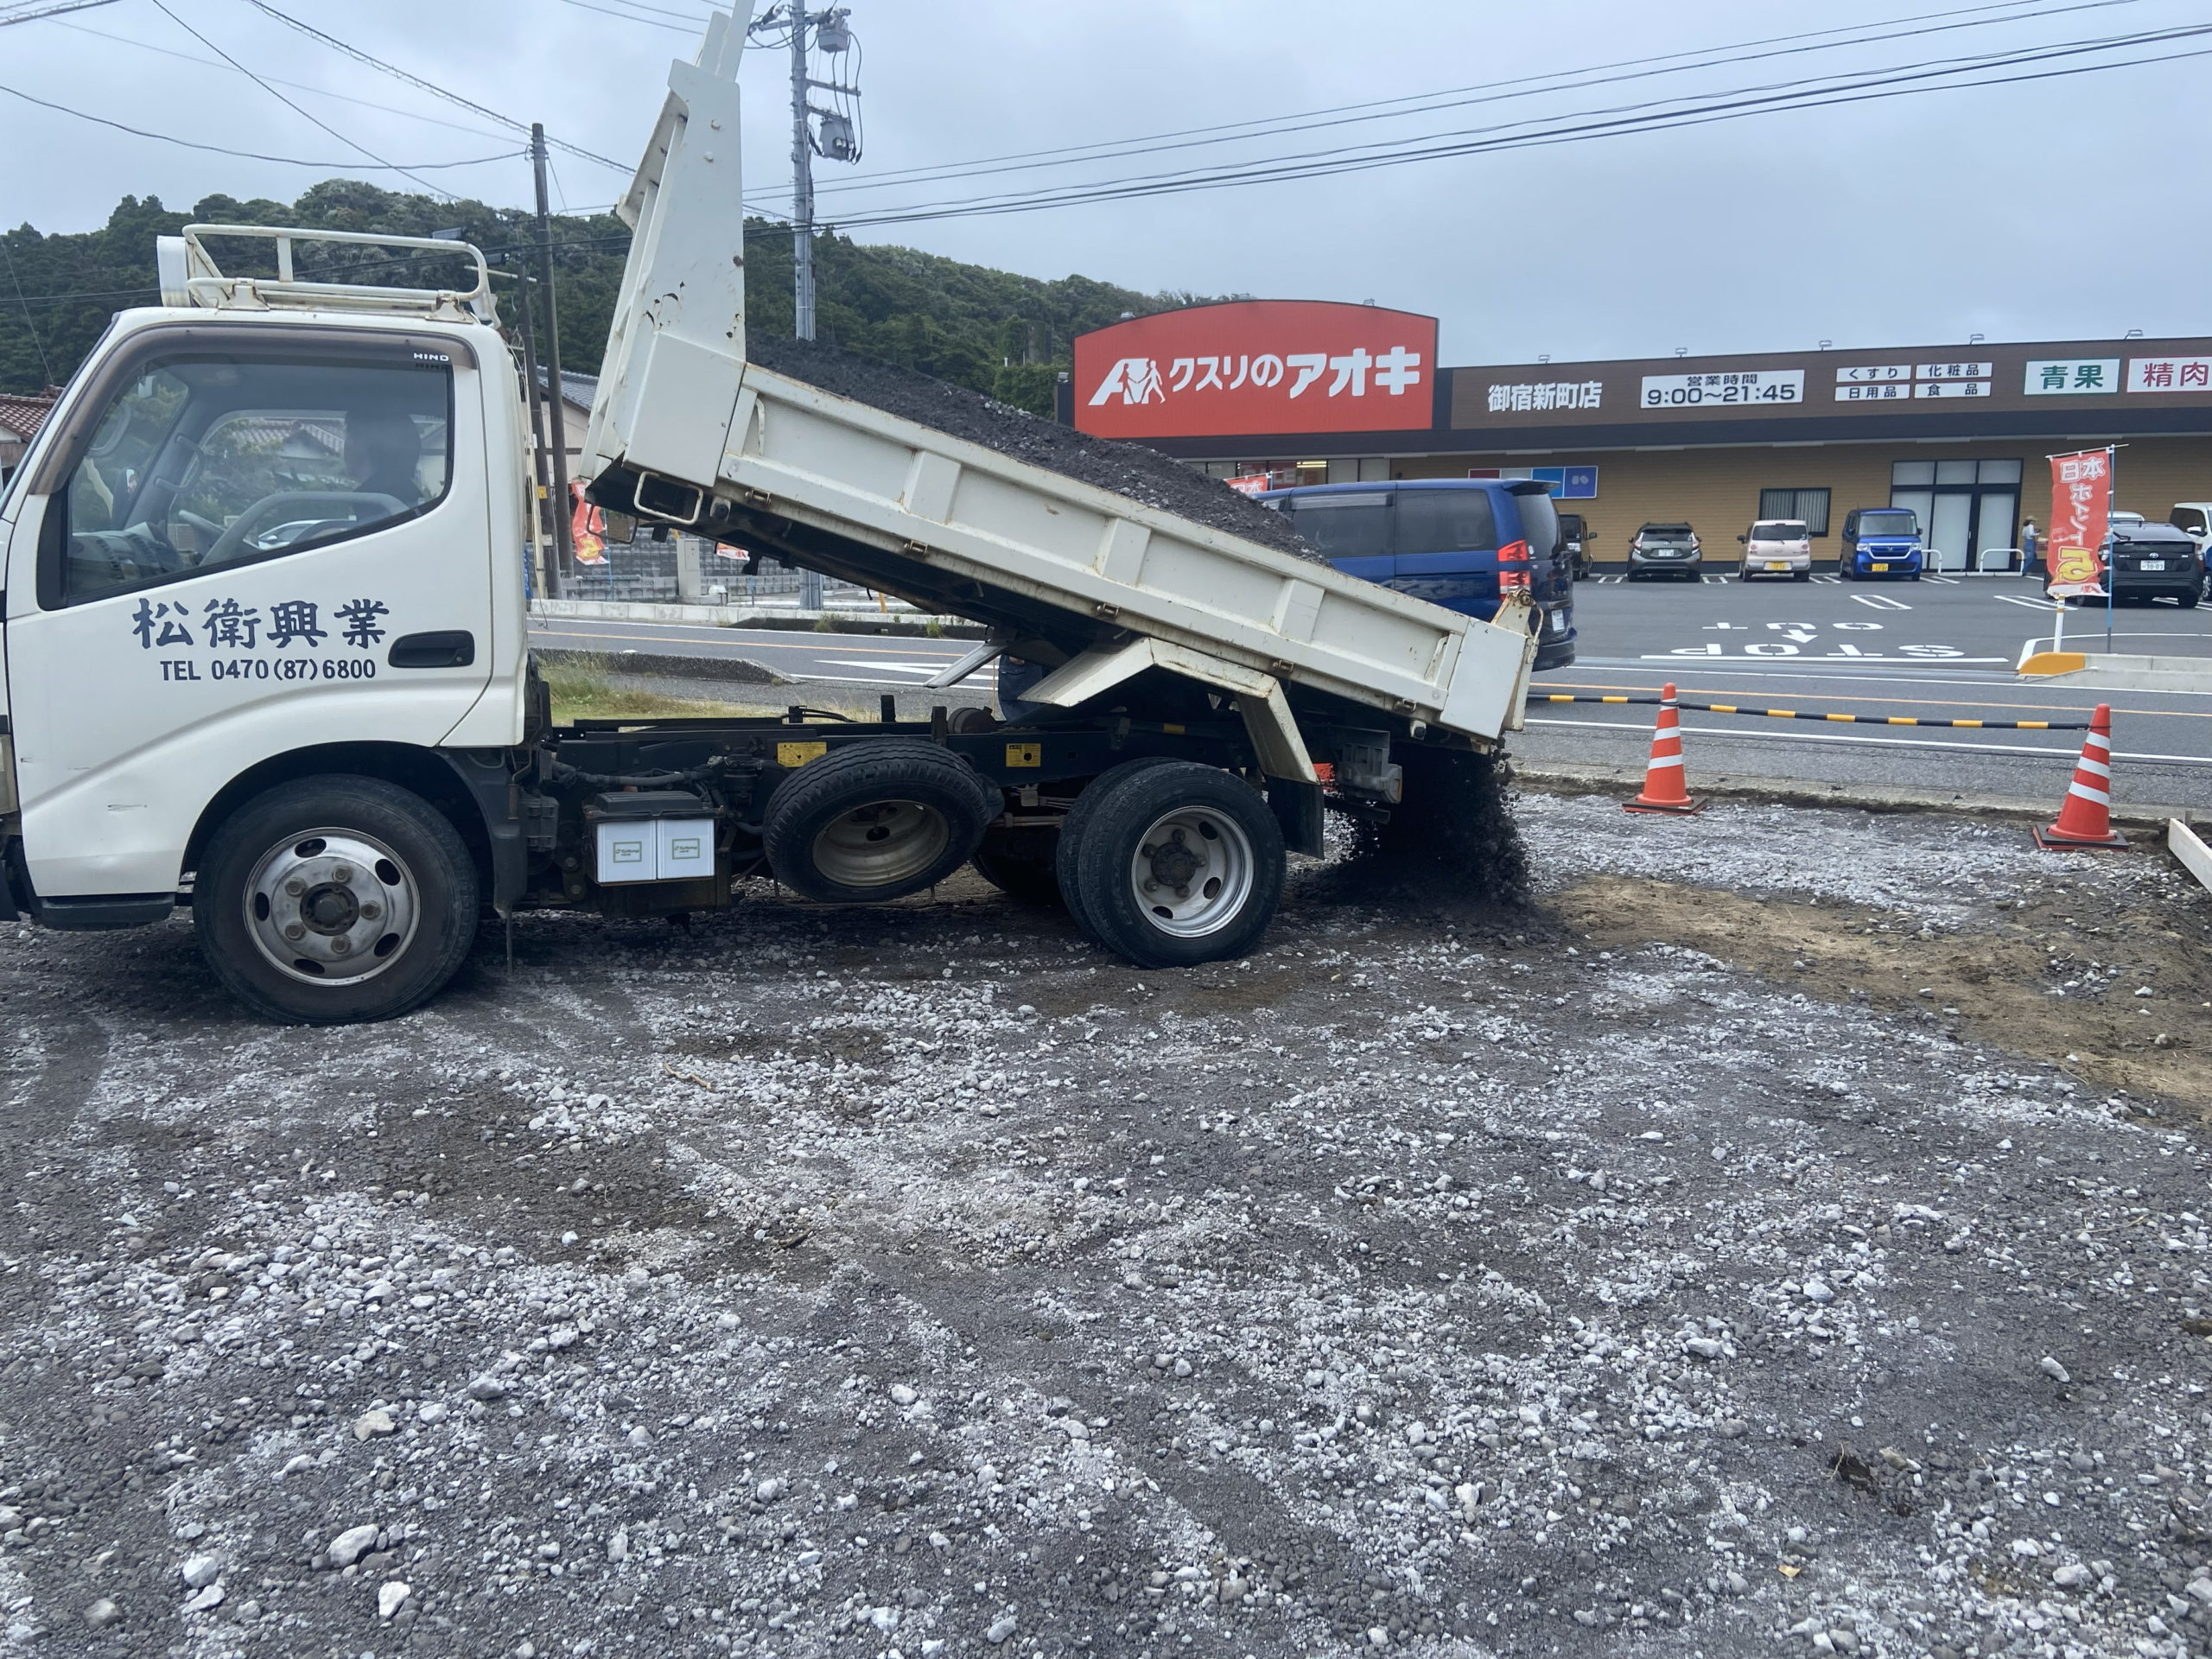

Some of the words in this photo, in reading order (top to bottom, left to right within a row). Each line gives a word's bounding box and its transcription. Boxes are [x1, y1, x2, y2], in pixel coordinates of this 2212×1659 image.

[414, 353, 449, 361] HINO
[1169, 346, 1421, 398] クスリのアオキ
[1849, 367, 1897, 379] くすり
[1929, 364, 1979, 377] 化粧品
[2040, 365, 2104, 390] 青果
[2143, 361, 2209, 388] 精肉
[1688, 374, 1758, 387] 営業時間
[1488, 380, 1603, 412] 御宿新町店
[1849, 385, 1897, 399] 日用品
[132, 598, 390, 649] 松衛興業
[1670, 643, 1965, 657] STOP
[160, 660, 201, 681] TEL
[211, 658, 376, 680] 0470(87)6800
